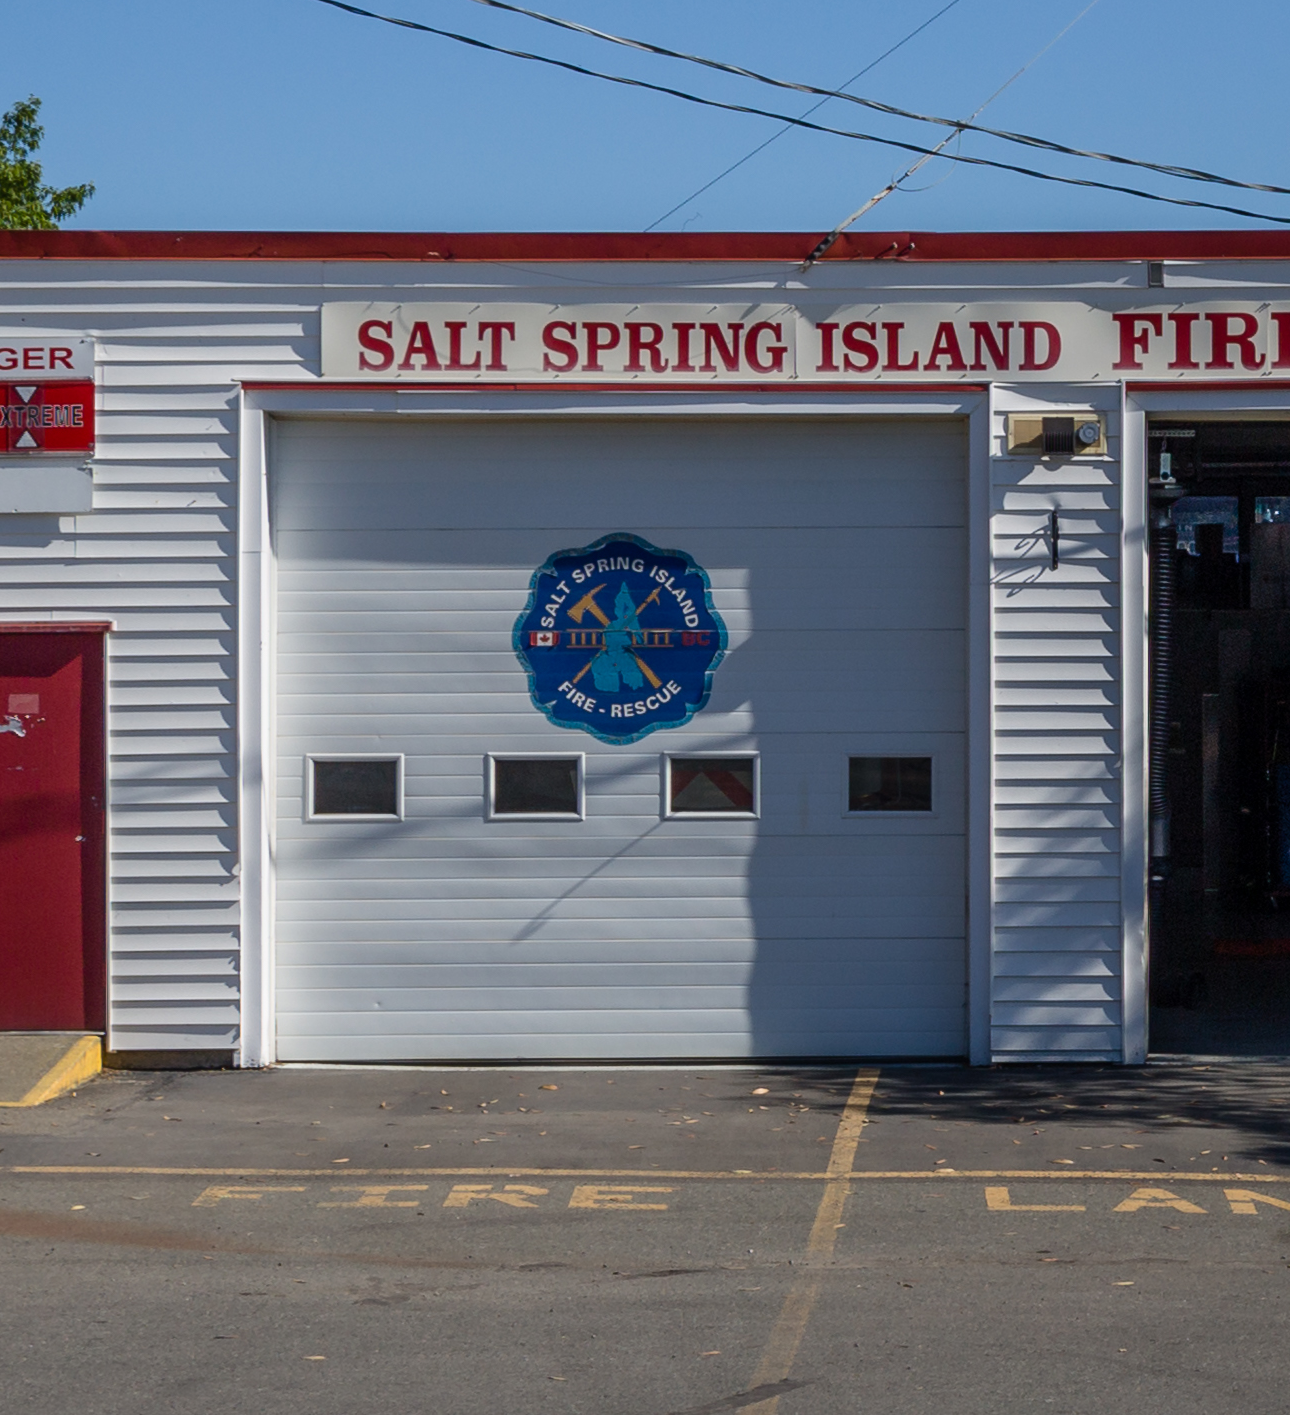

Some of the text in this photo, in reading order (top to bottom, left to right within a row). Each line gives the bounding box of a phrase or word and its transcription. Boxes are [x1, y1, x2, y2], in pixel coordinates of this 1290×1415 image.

[357, 319, 515, 372] SALT
[542, 320, 790, 374] SPRING
[815, 319, 1063, 373] ISLAND
[540, 556, 699, 629] SALT SPRING ISLAND
[682, 631, 711, 646] BC
[557, 681, 597, 713] FIRE
[610, 680, 682, 718] RESCUE
[191, 1184, 680, 1211] FIRE
